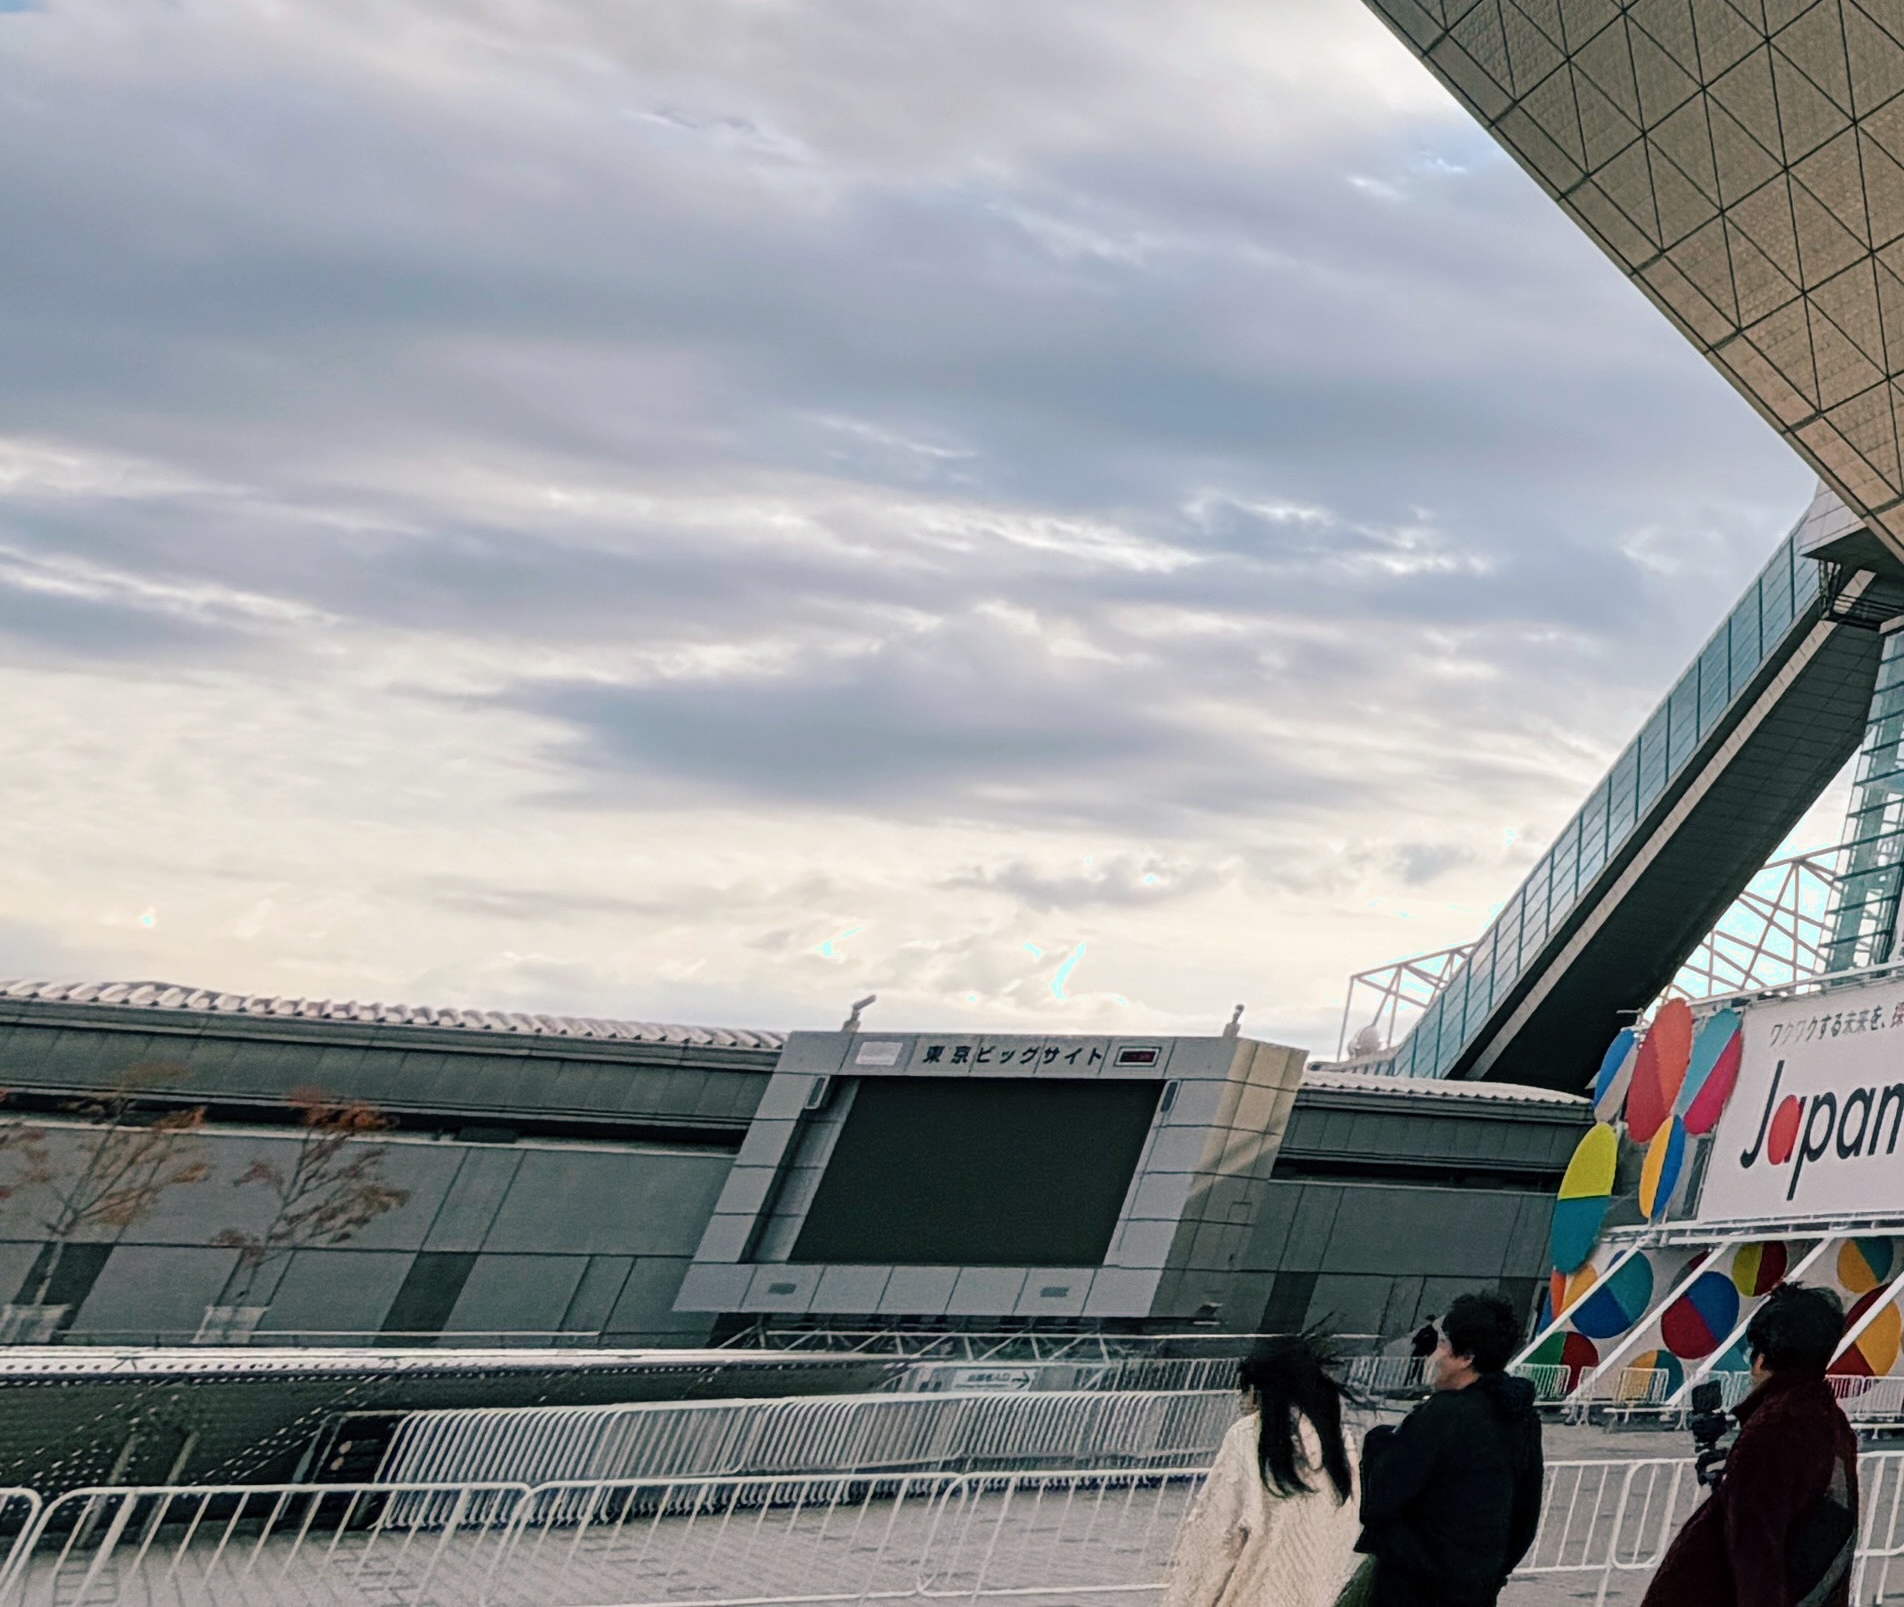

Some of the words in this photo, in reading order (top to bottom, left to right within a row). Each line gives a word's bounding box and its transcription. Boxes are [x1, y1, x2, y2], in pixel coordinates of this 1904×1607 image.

[922, 1045, 1103, 1066] 東京ビッグサイト
